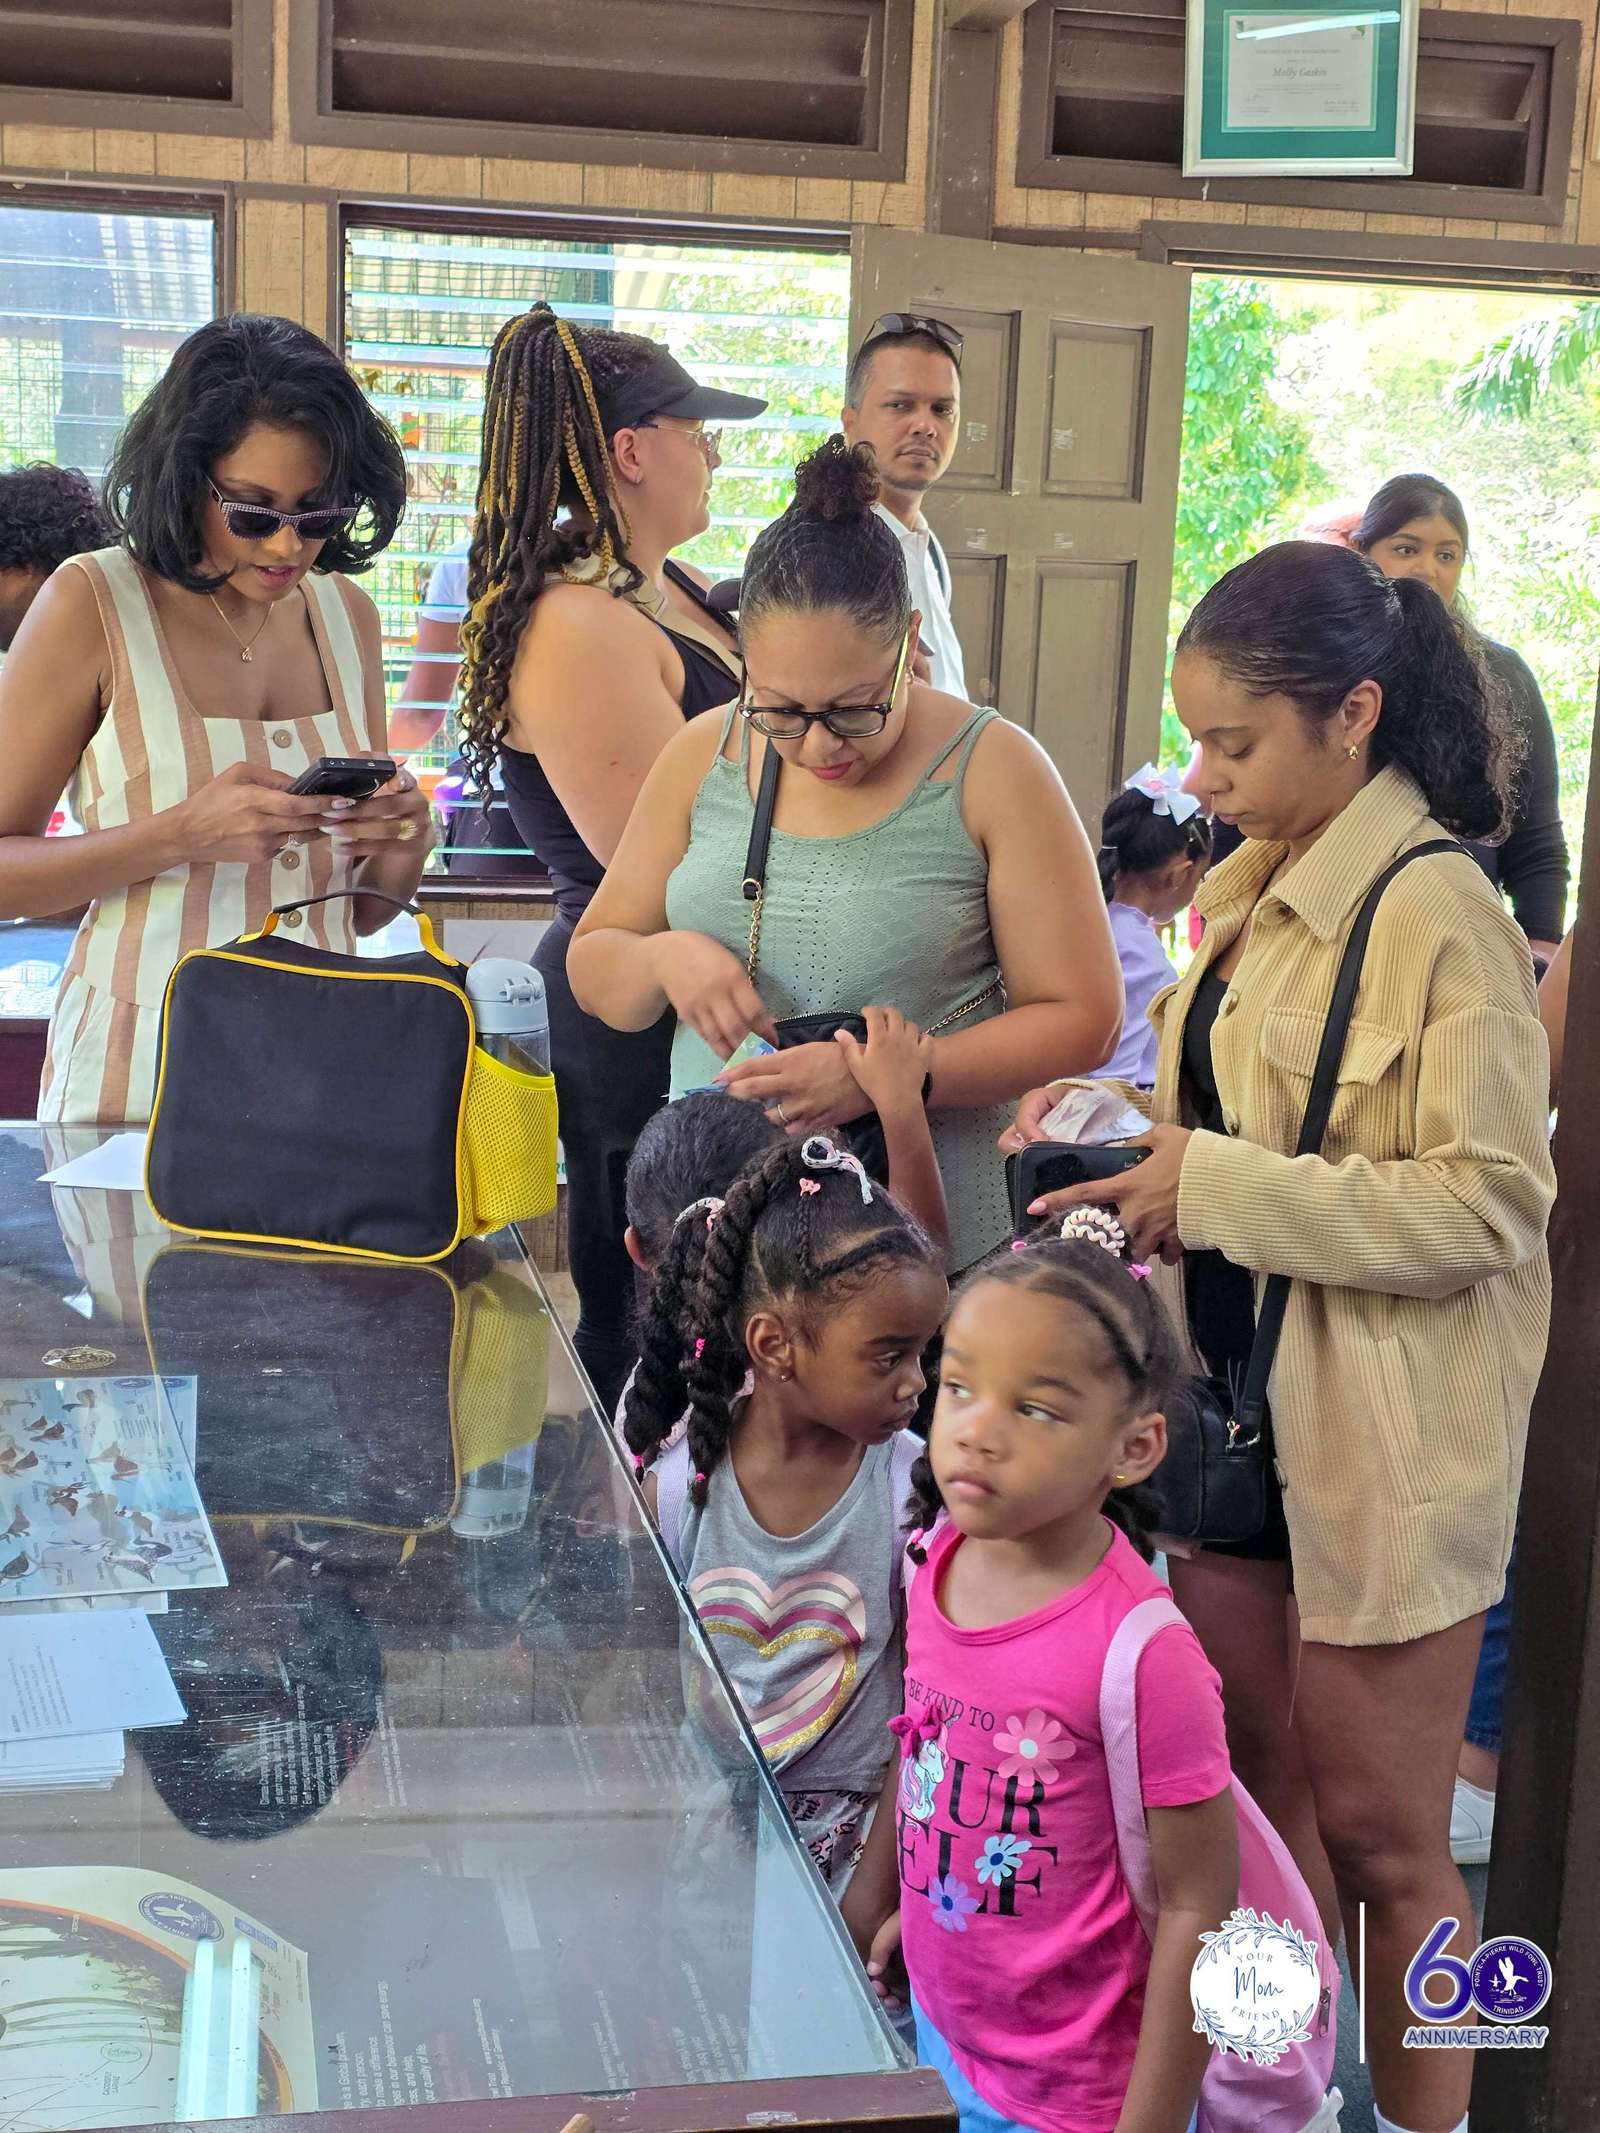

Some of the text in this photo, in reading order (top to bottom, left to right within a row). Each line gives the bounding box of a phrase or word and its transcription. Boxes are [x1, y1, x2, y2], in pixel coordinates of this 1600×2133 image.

[909, 1678, 995, 1732] BE KIND TO
